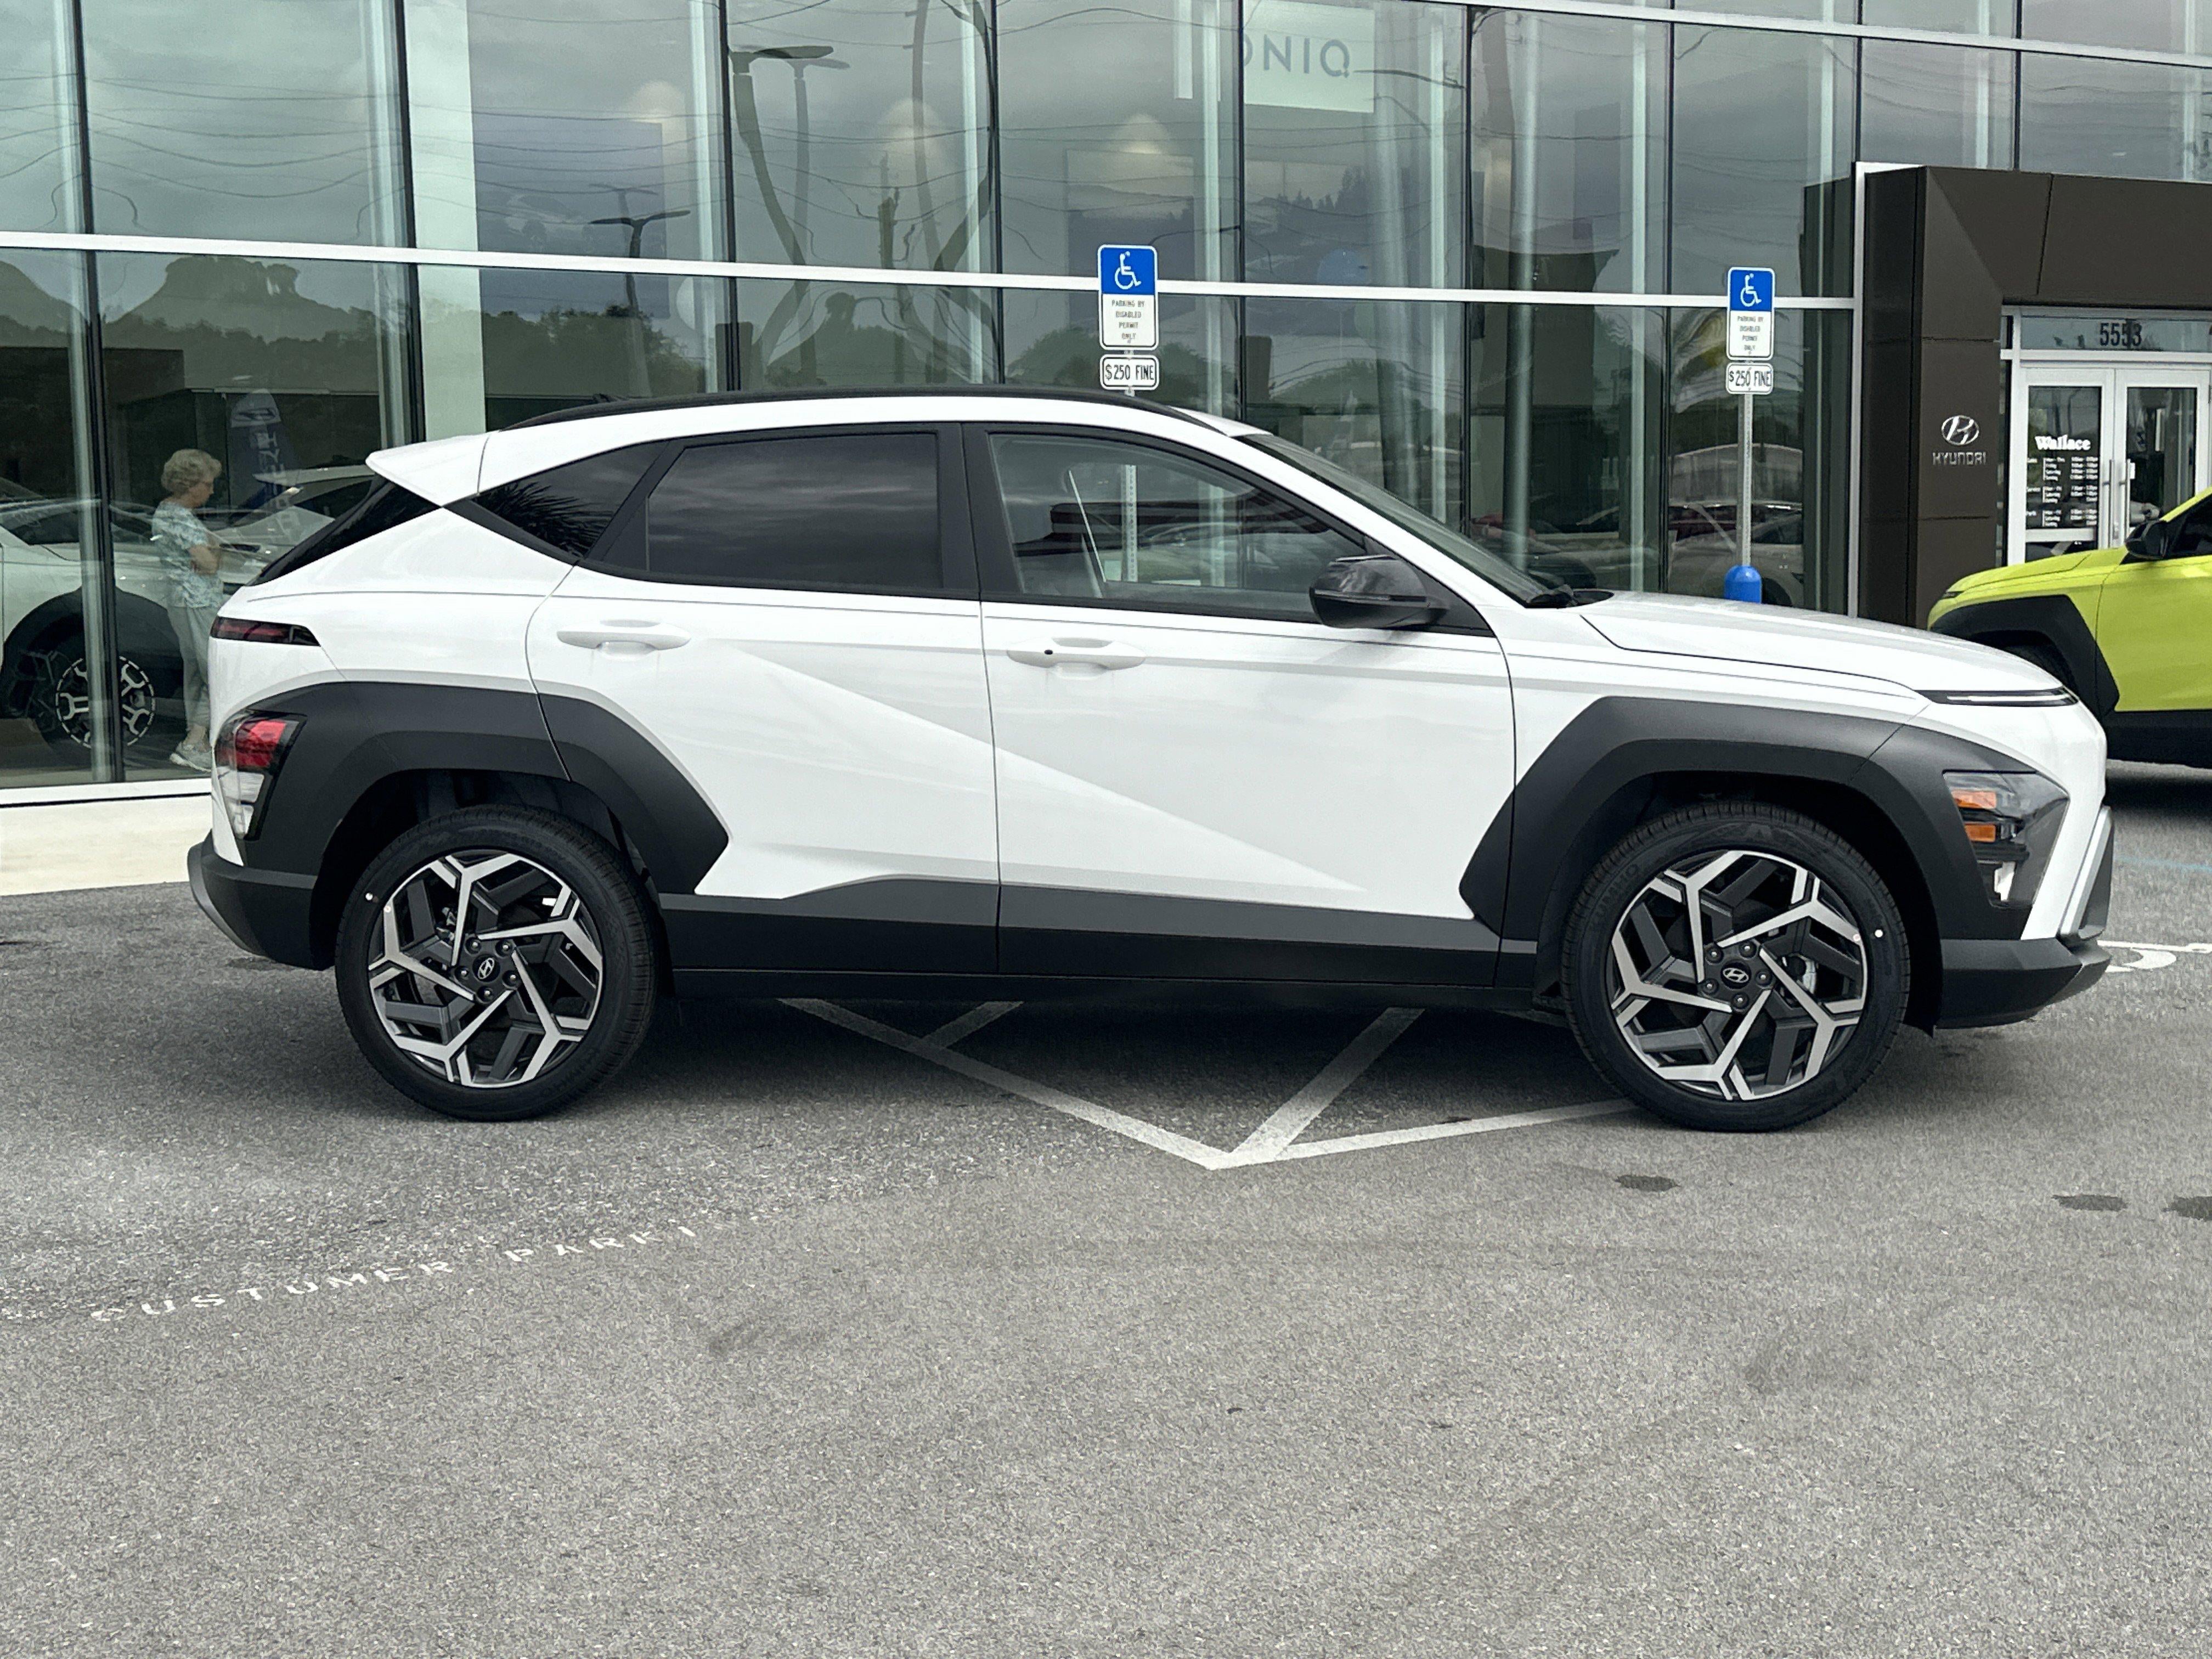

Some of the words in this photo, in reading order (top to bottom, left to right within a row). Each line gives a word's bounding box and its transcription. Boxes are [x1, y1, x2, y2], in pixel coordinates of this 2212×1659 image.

[2099, 322, 2142, 347] 5553
[1105, 364, 1131, 381] $250
[1136, 365, 1154, 380] FINE
[1754, 370, 1772, 387] FINE
[2034, 434, 2091, 450] Wallace
[1932, 452, 1987, 466] HYUNDAI
[91, 1261, 454, 1322] CUSTOMER
